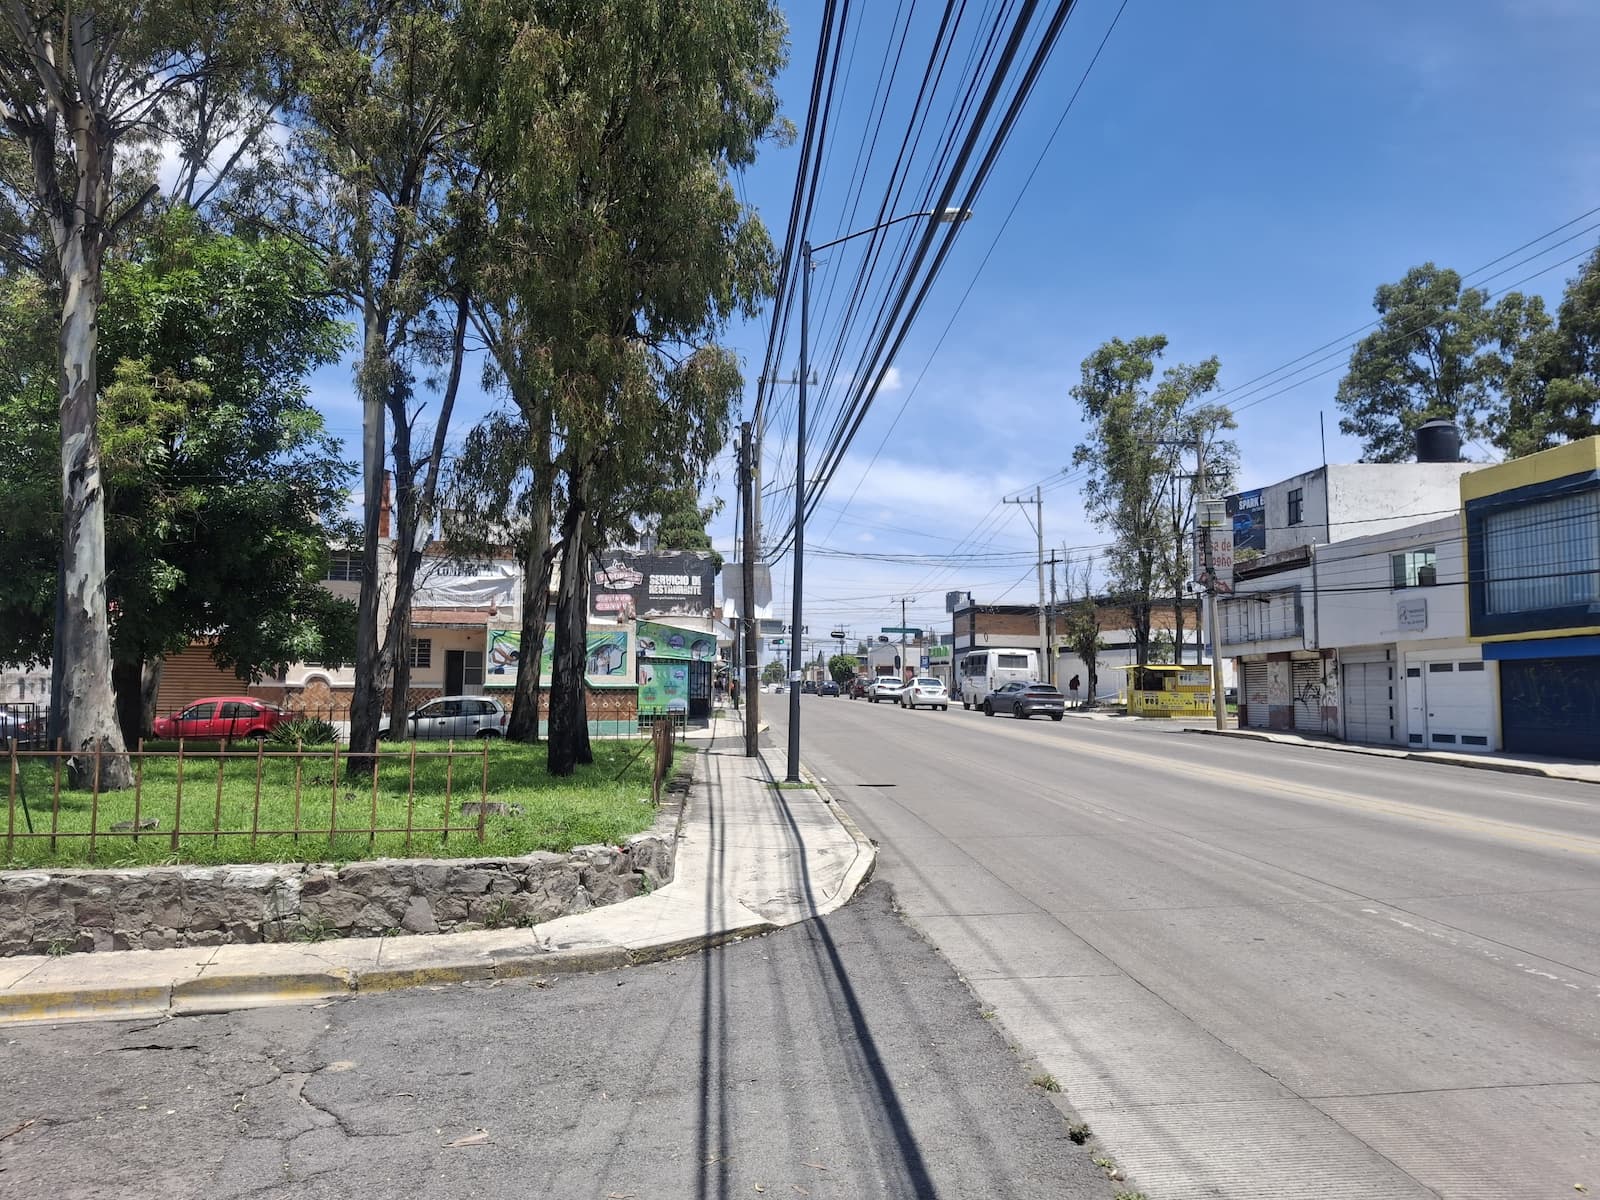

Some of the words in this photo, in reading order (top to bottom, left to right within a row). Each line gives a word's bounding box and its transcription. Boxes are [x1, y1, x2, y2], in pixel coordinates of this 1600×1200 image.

[1239, 497, 1259, 510] SPARK
[1222, 538, 1231, 552] de
[1199, 552, 1231, 567] Epeño
[649, 574, 689, 585] SERVICIO
[649, 585, 702, 595] RESTAURANTE
